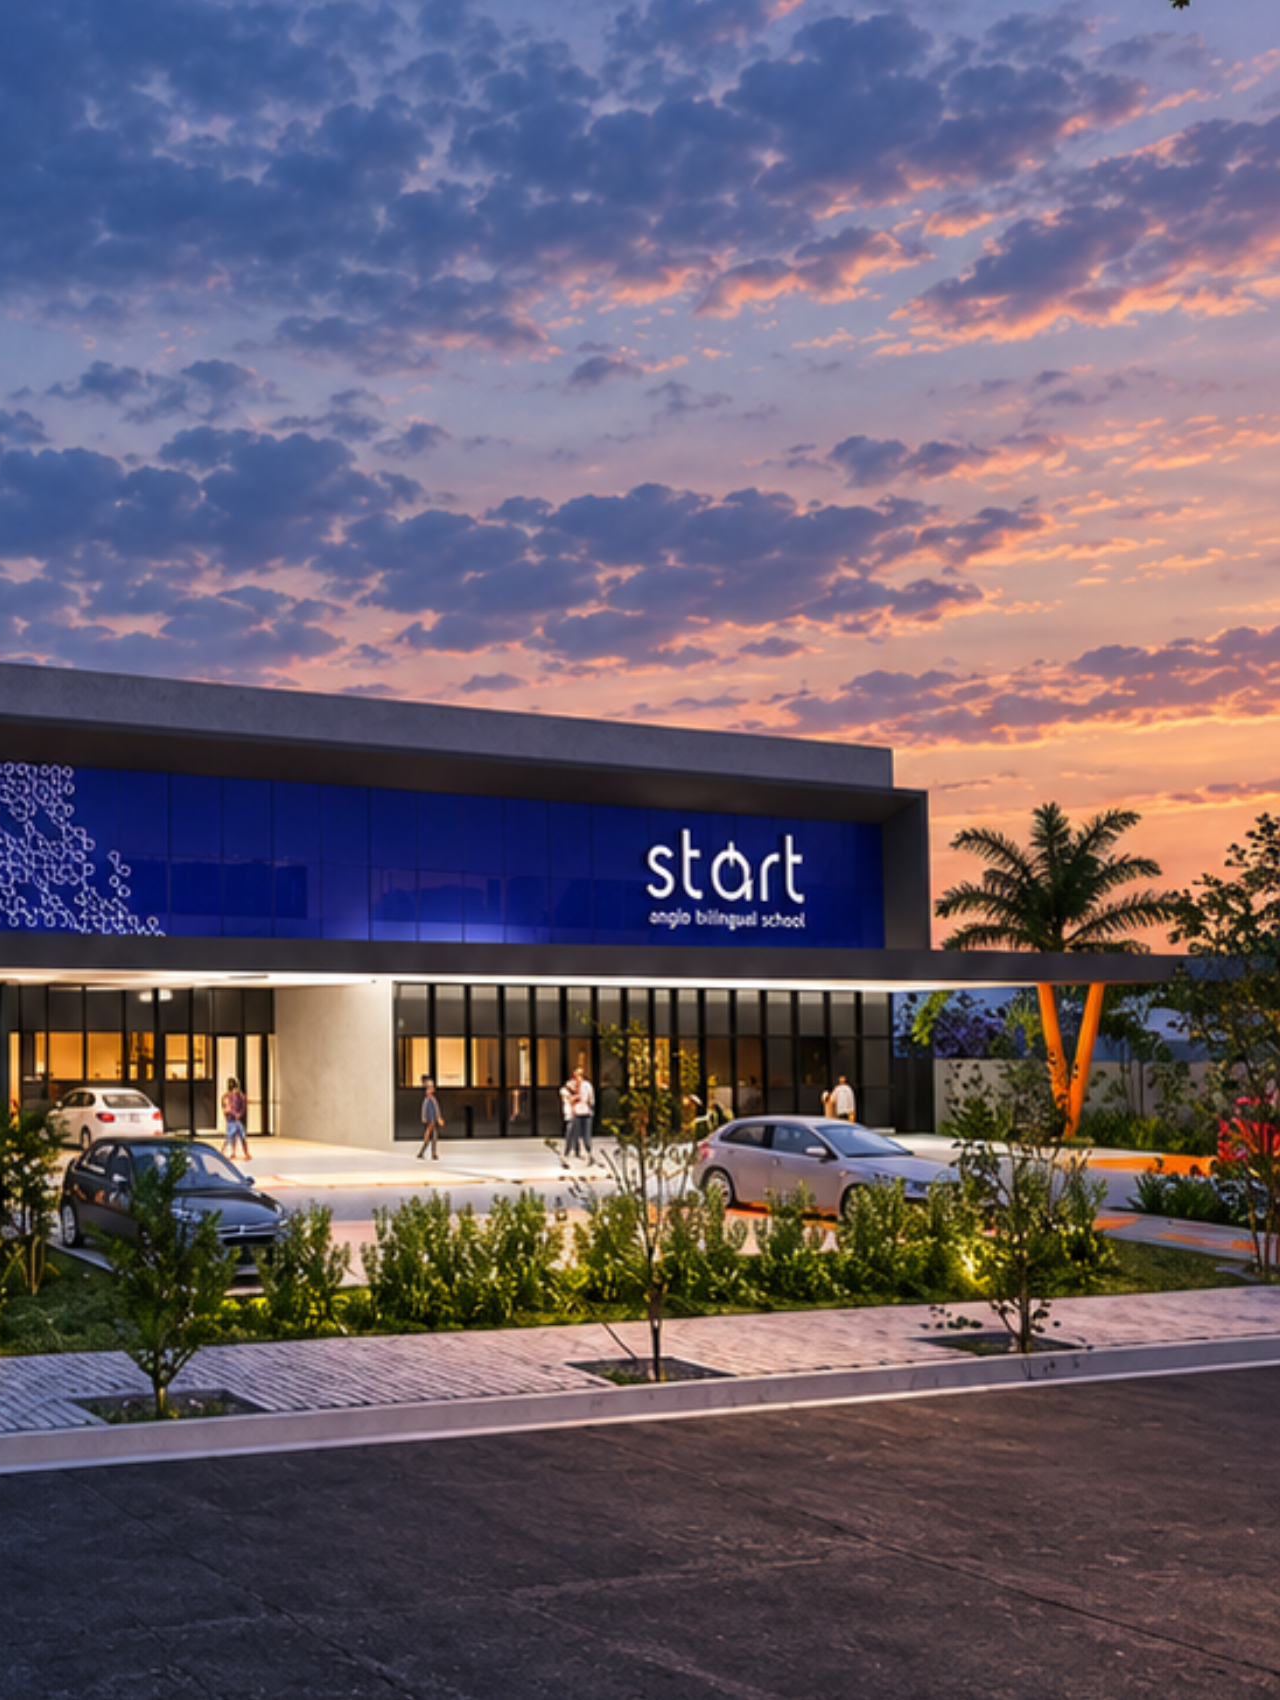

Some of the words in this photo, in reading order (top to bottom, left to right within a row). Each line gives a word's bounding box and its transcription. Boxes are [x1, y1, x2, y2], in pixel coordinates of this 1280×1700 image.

[646, 828, 805, 904] start
[648, 908, 691, 930] anglo
[695, 909, 758, 931] bilingual
[762, 912, 806, 929] school
